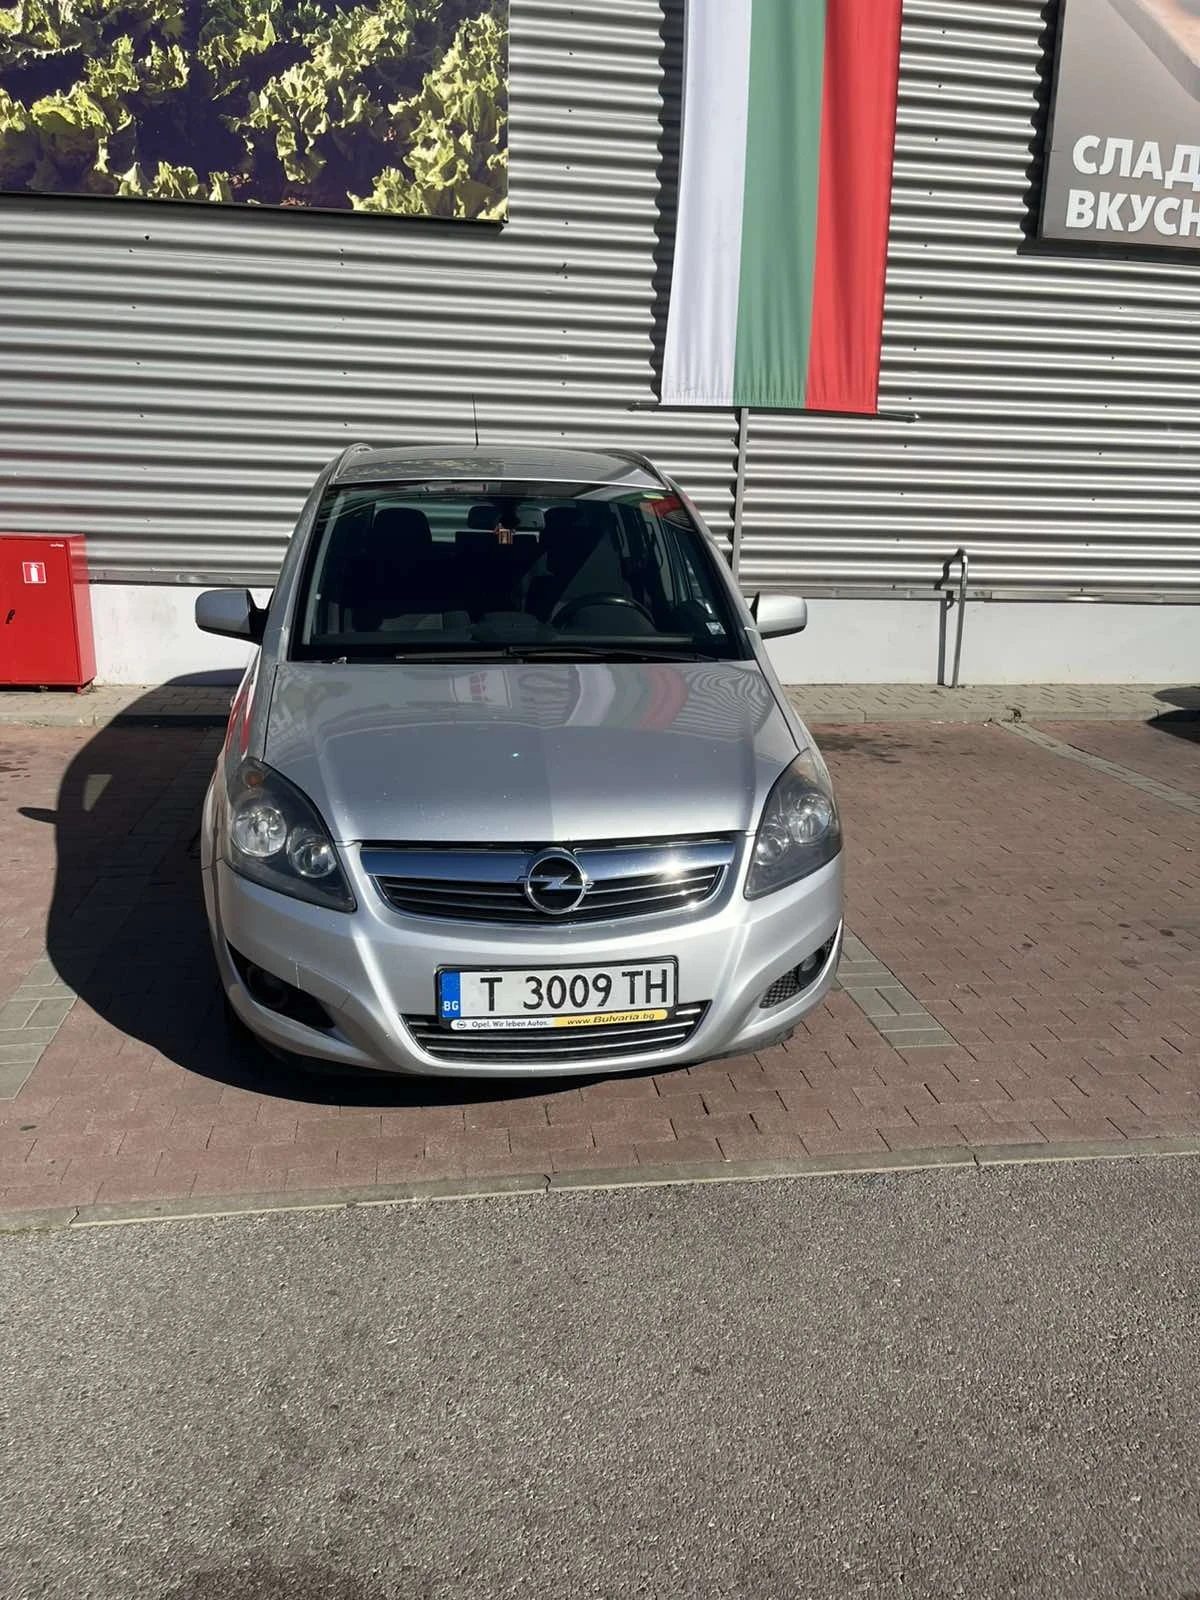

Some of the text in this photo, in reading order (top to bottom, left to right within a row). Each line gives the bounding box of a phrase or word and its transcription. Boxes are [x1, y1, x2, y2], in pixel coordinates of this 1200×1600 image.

[1072, 134, 1200, 192] СЛАД
[1065, 188, 1200, 237] ВКУСН
[443, 1000, 459, 1012] BG
[480, 969, 668, 1011] T 3009 TH
[567, 1013, 655, 1025] www.Bulvaria.bg
